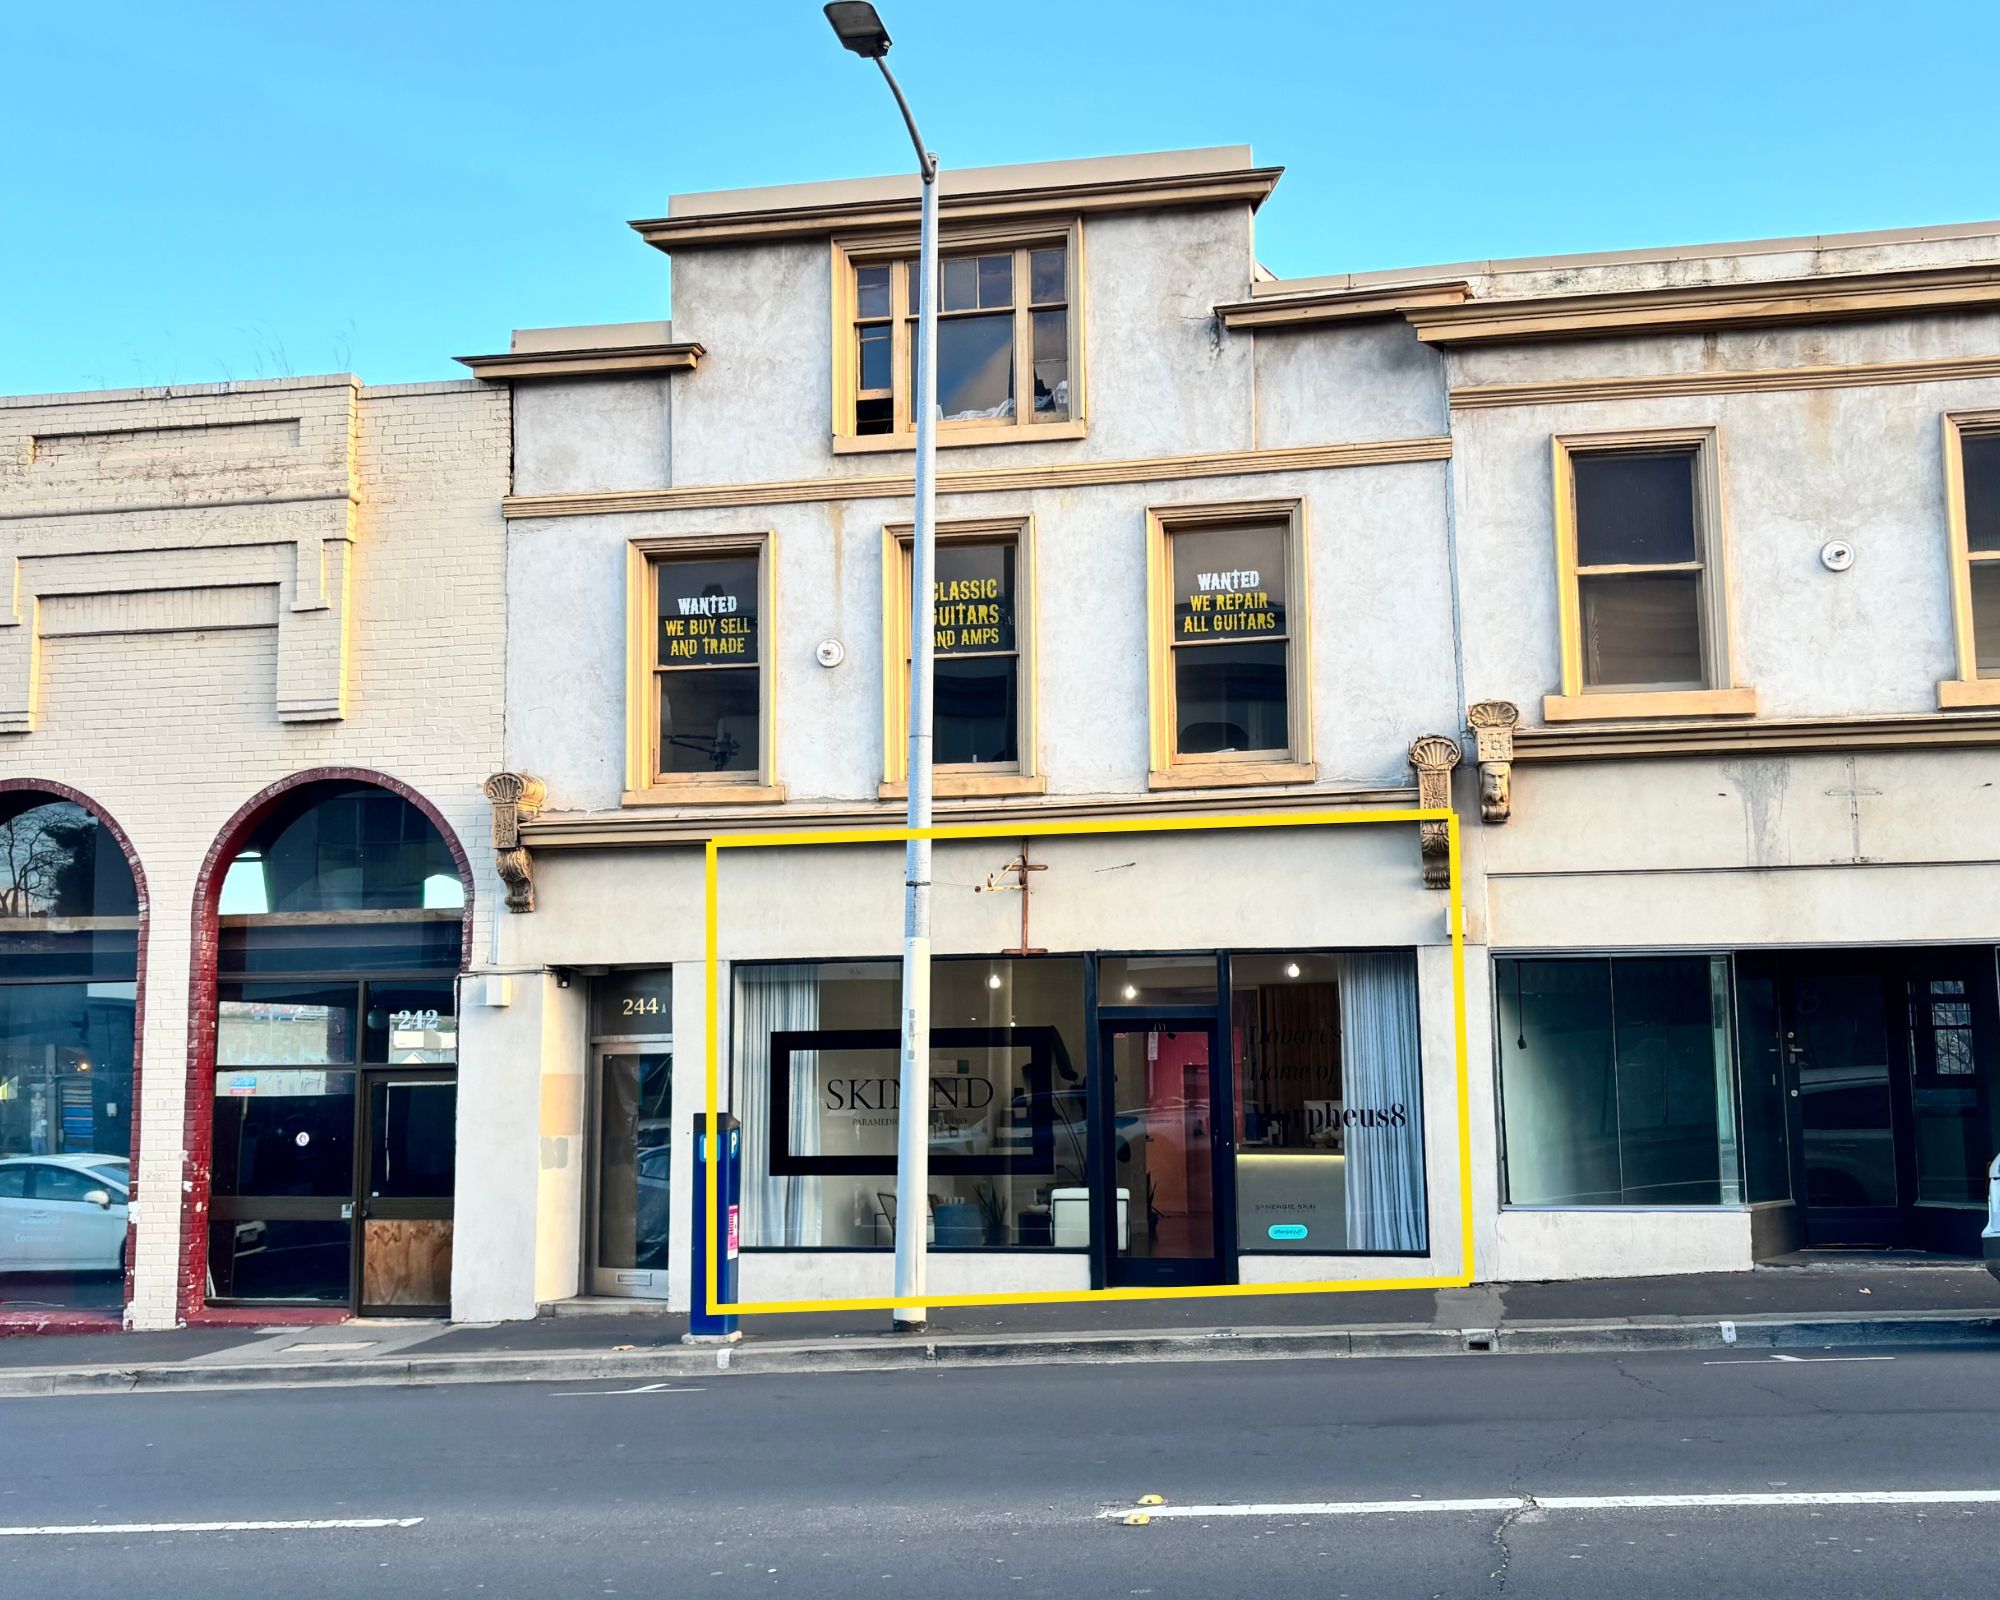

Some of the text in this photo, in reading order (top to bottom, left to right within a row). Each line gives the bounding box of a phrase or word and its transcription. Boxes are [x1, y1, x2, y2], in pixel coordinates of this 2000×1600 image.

[1197, 569, 1260, 592] WANTED
[677, 595, 737, 617] WANTED
[1190, 592, 1268, 612] WE REPAIR
[934, 602, 999, 627] UITARS
[1184, 611, 1275, 633] ALL GUITARS
[665, 617, 751, 636] WE BUY SELL
[670, 636, 745, 659] AND TRADE
[934, 627, 999, 649] ND AMPS
[623, 997, 659, 1015] 244
[398, 1010, 438, 1030] 242
[731, 1132, 737, 1154] P
